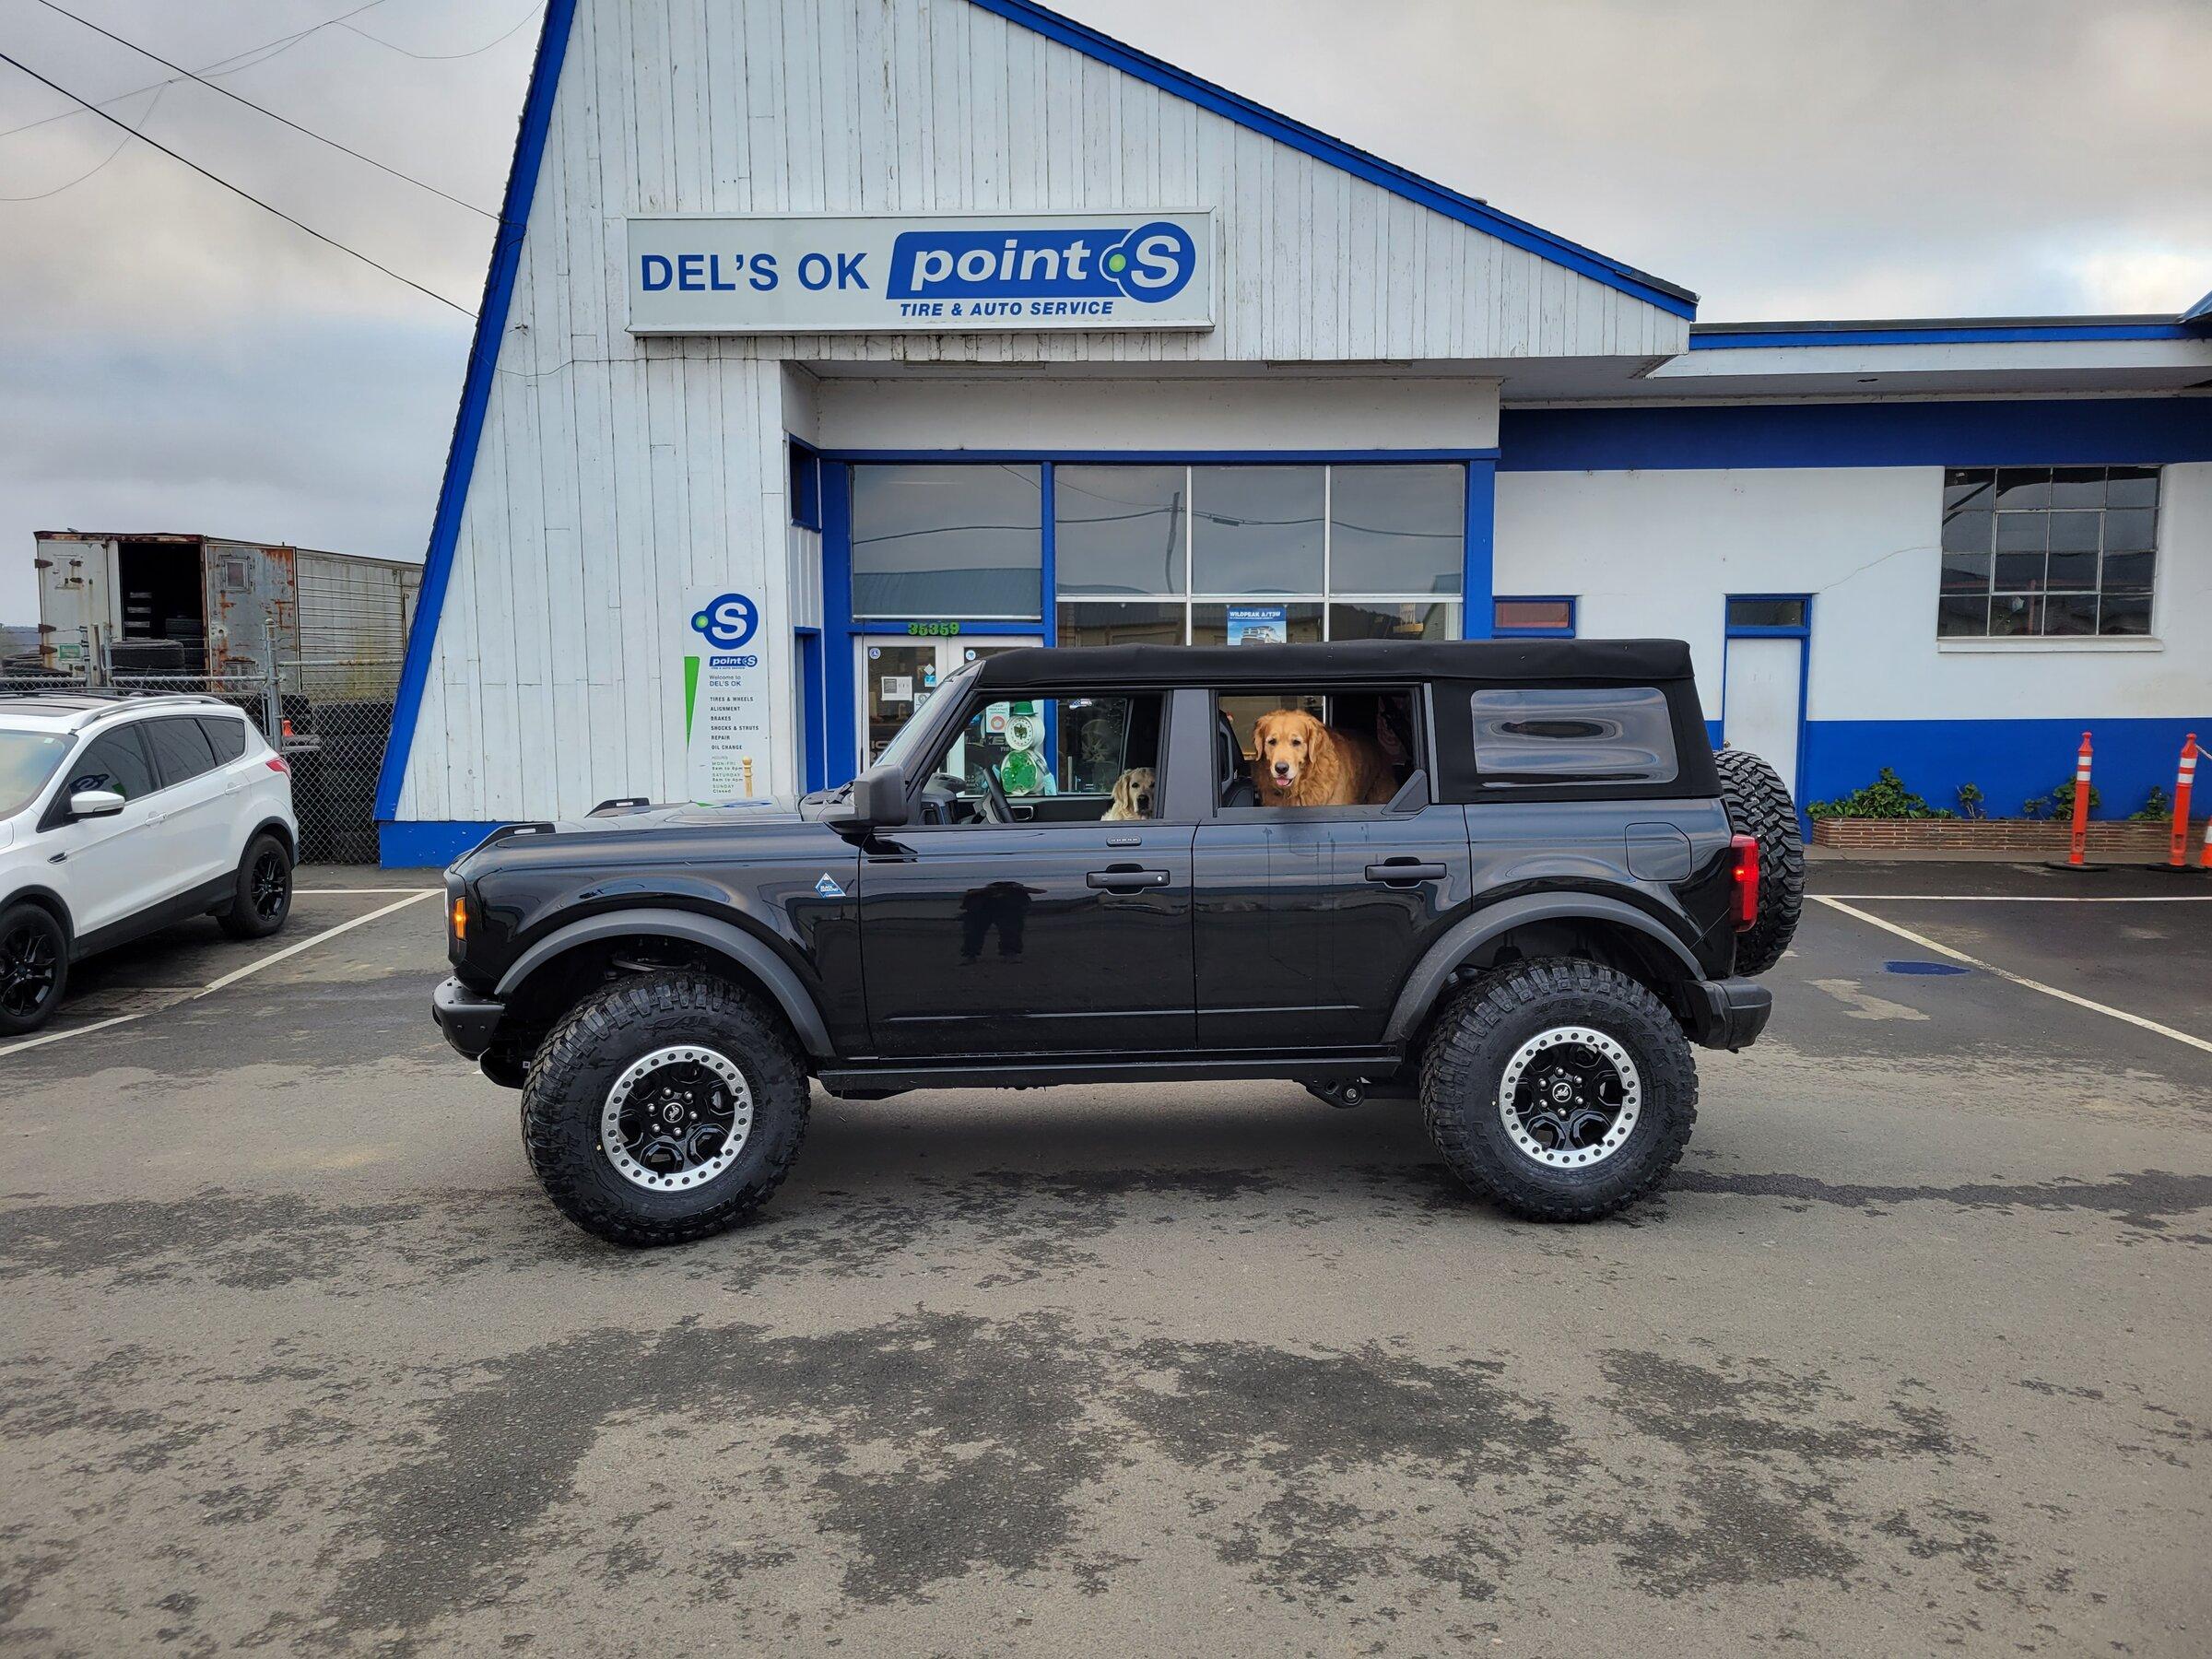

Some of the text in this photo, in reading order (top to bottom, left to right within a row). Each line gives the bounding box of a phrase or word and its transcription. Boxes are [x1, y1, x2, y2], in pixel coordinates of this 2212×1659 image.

[641, 252, 870, 291] DEL'S OK
[911, 235, 1181, 292] point S
[900, 300, 1113, 317] TIRE & AUTO SERVICE
[712, 602, 748, 641] S
[712, 656, 756, 666] point S
